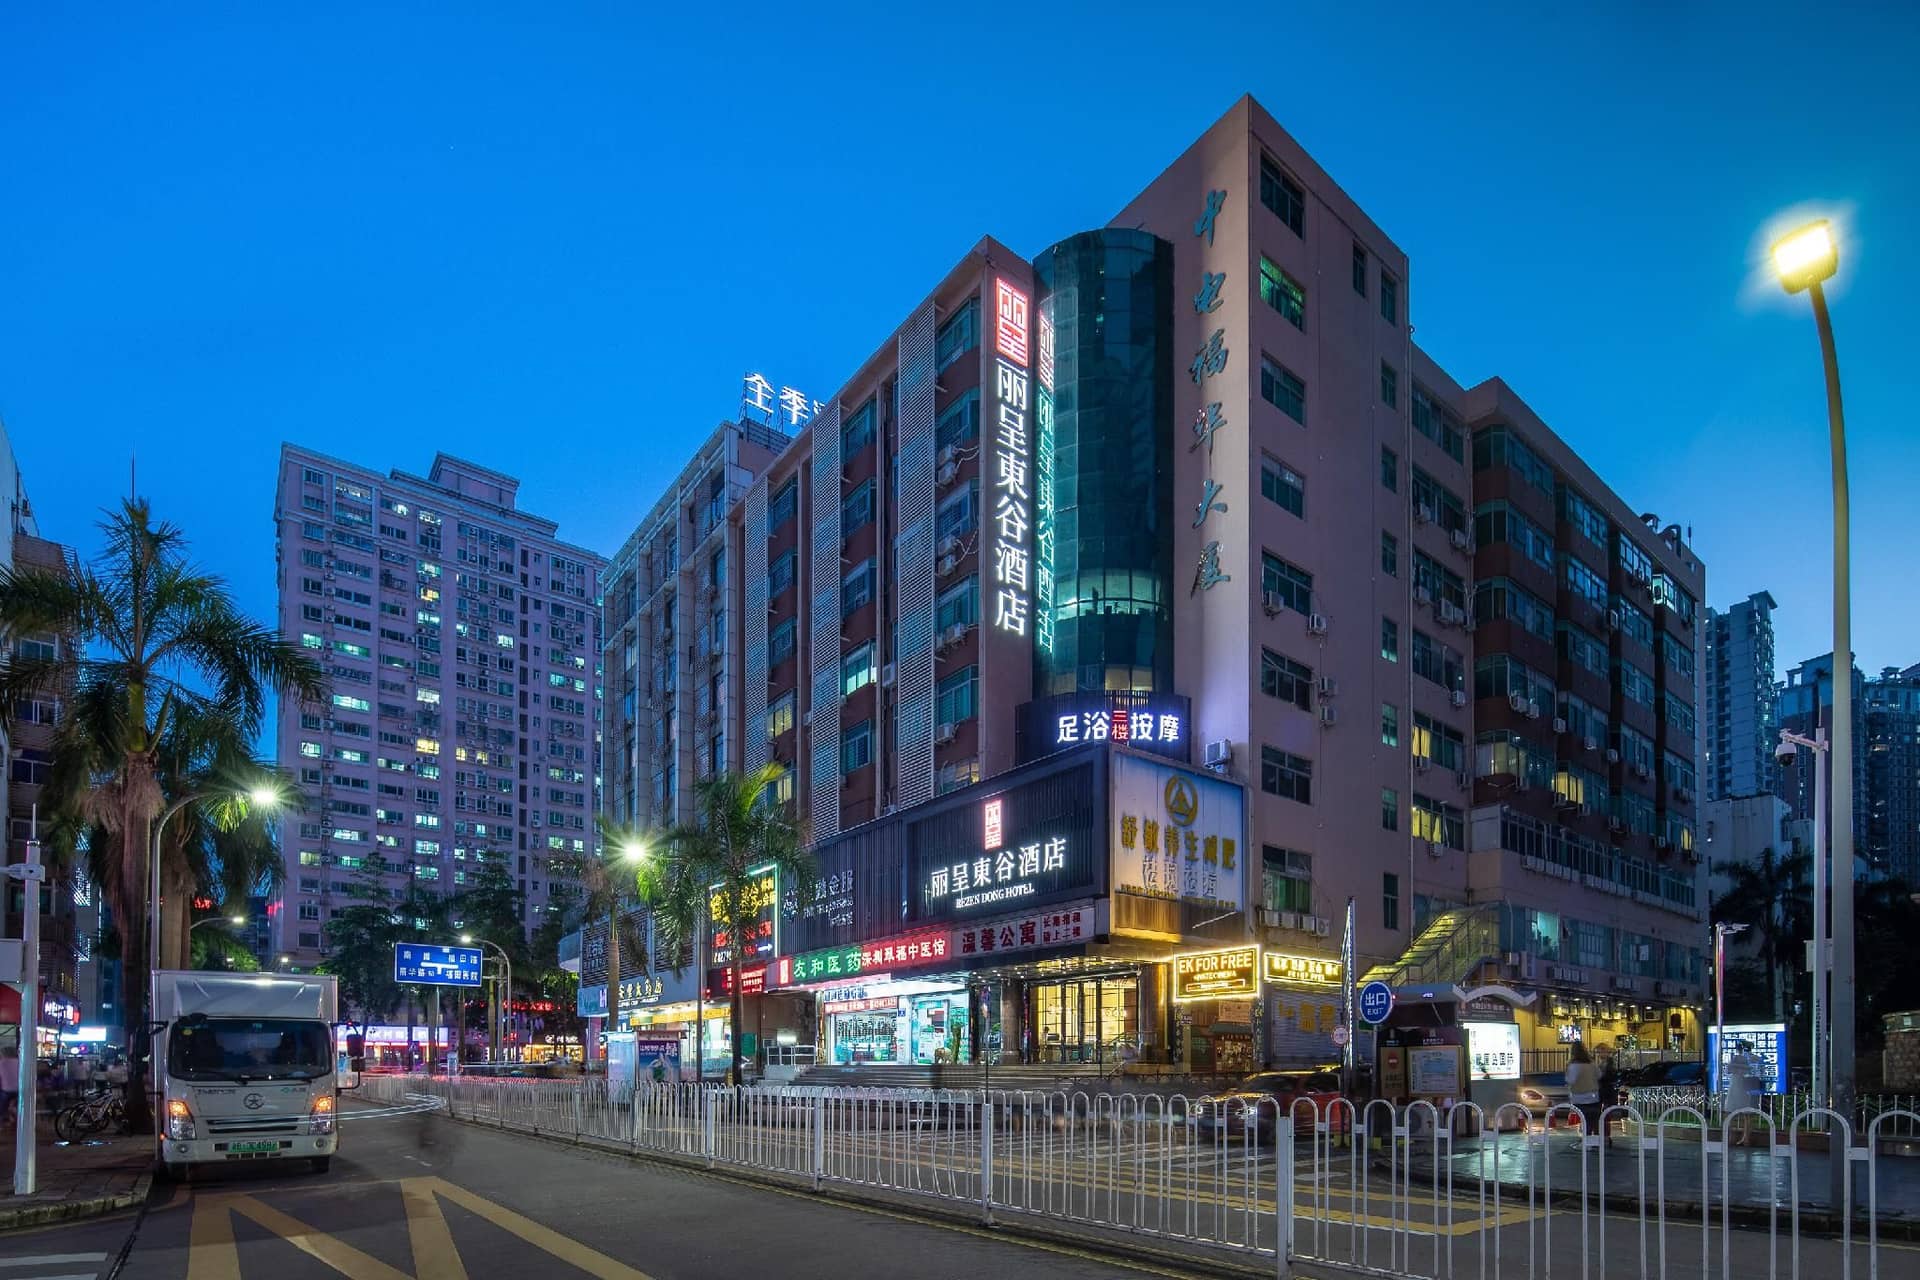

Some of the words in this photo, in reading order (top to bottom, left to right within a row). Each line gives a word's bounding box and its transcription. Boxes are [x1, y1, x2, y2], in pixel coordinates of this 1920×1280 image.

[743, 373, 826, 426] 全季
[1188, 187, 1231, 600] 中电福华大厦
[995, 357, 1029, 637] 丽呈東谷酒店
[1057, 711, 1110, 743] 足浴
[1111, 710, 1129, 741] 三楼
[1130, 712, 1180, 742] 按摩
[931, 837, 1067, 898] 丽呈東谷酒店
[955, 893, 981, 909] REZEN
[981, 886, 1005, 904] DONG
[1005, 882, 1035, 899] HOTEL
[962, 921, 1036, 954] 温馨公寓
[793, 951, 862, 979] 友和医药
[1179, 958, 1194, 973] EK
[1195, 956, 1219, 972] FOR
[1220, 952, 1253, 970] FREE
[1365, 992, 1387, 1006] 出口
[1367, 1007, 1385, 1016] EXIT
